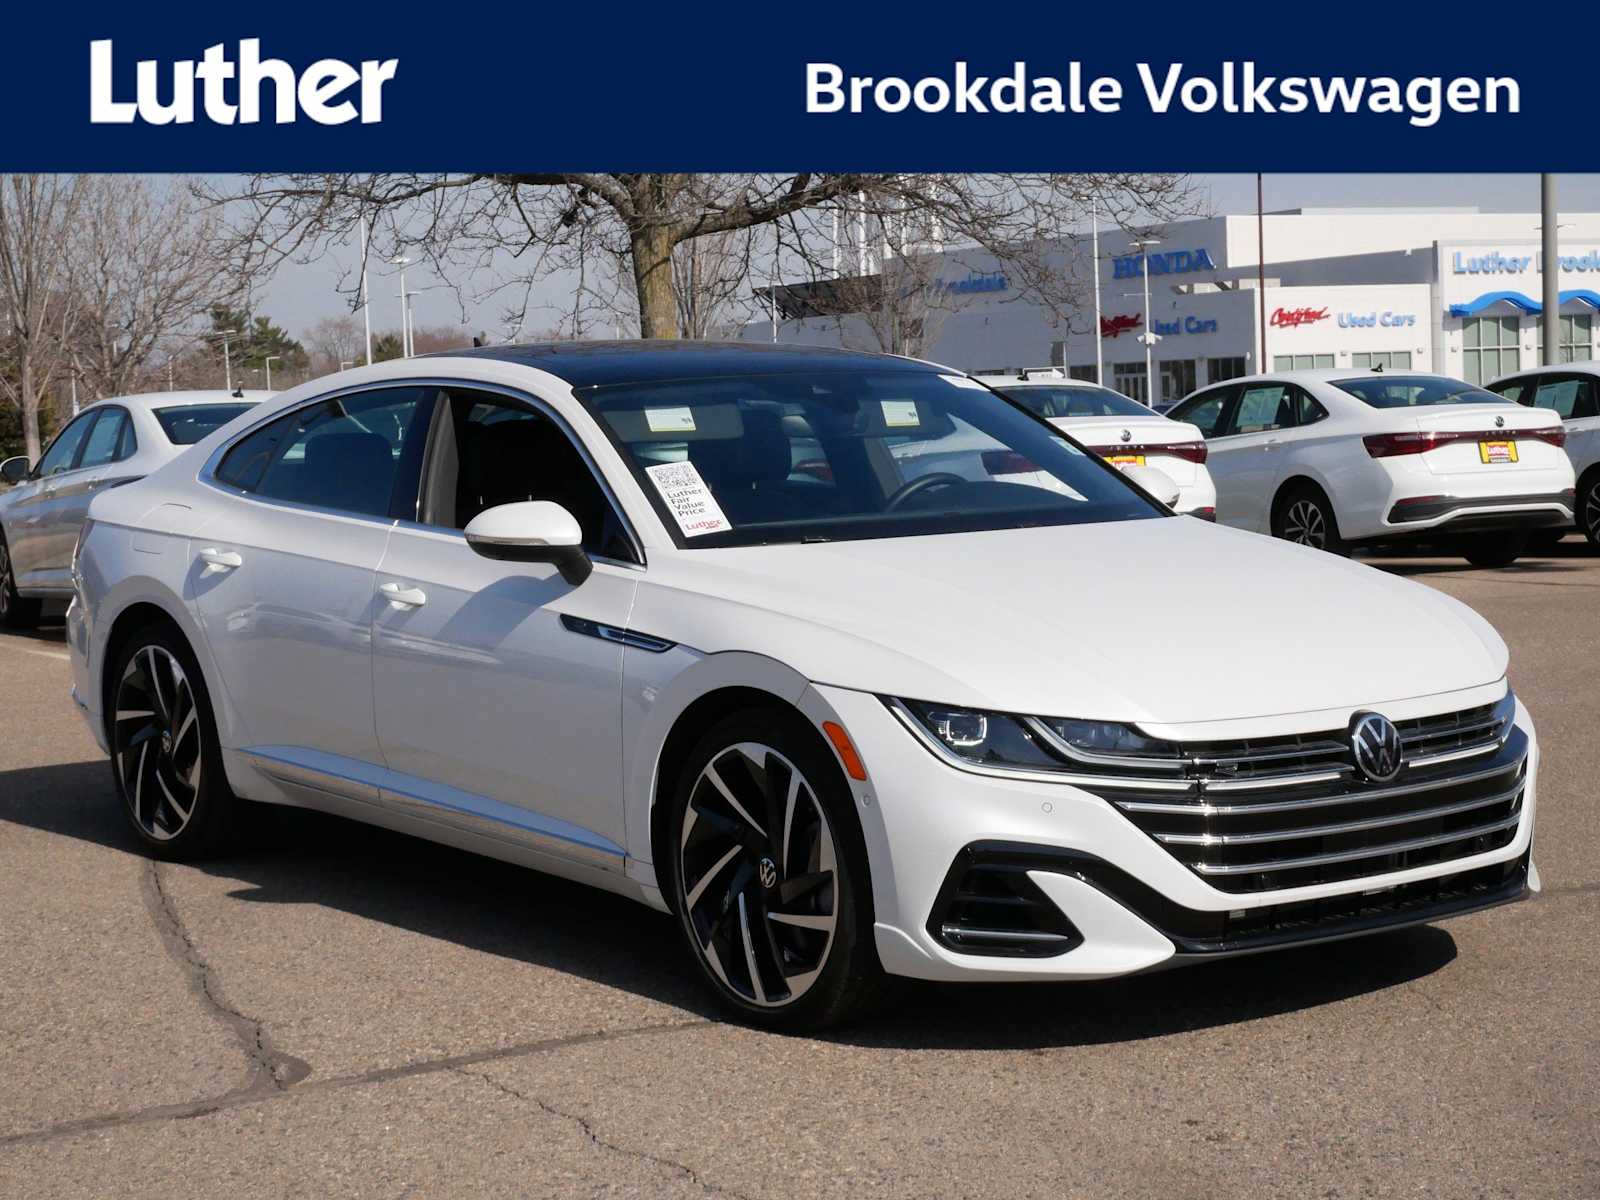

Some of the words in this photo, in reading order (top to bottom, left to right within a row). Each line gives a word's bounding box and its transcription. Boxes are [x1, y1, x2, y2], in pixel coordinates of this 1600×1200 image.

[1112, 249, 1216, 279] HONDA
[1453, 250, 1532, 275] Luther
[1337, 312, 1377, 329] Used
[1379, 311, 1417, 328] Cars
[667, 489, 702, 499] Luther
[670, 497, 690, 505] Fair
[674, 501, 705, 510] Value
[678, 508, 706, 517] Price
[685, 519, 722, 531] Luther
